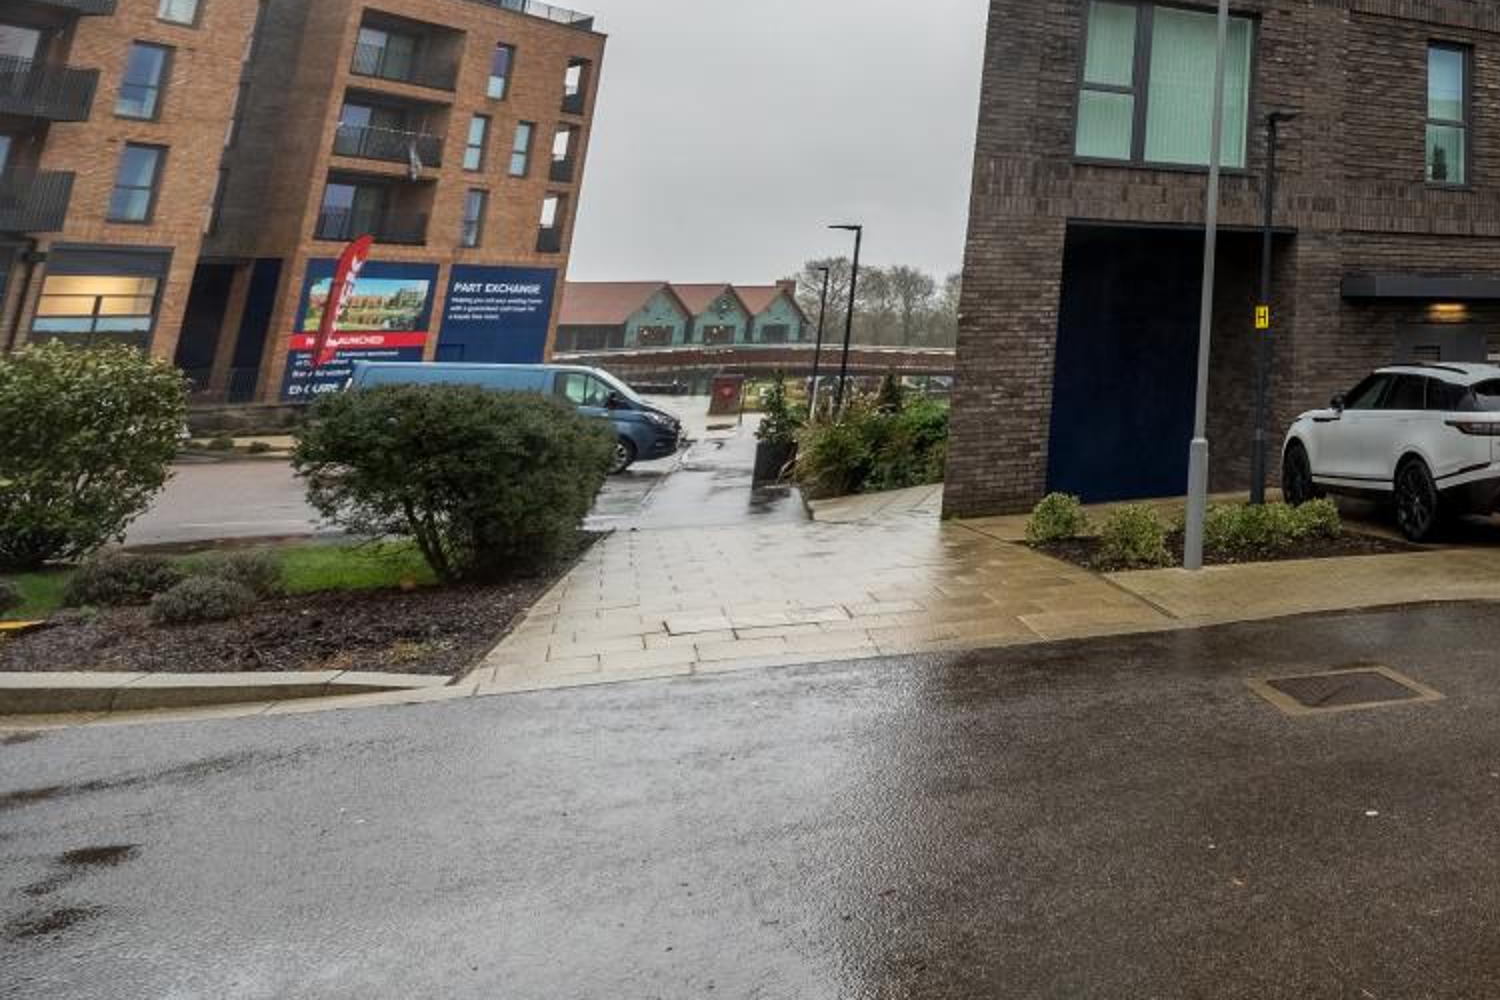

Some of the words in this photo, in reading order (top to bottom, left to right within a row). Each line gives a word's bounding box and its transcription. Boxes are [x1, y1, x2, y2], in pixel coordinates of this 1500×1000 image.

[453, 282, 482, 293] PART
[485, 283, 541, 295] EXCHANGE
[336, 335, 385, 346] AUNCHED
